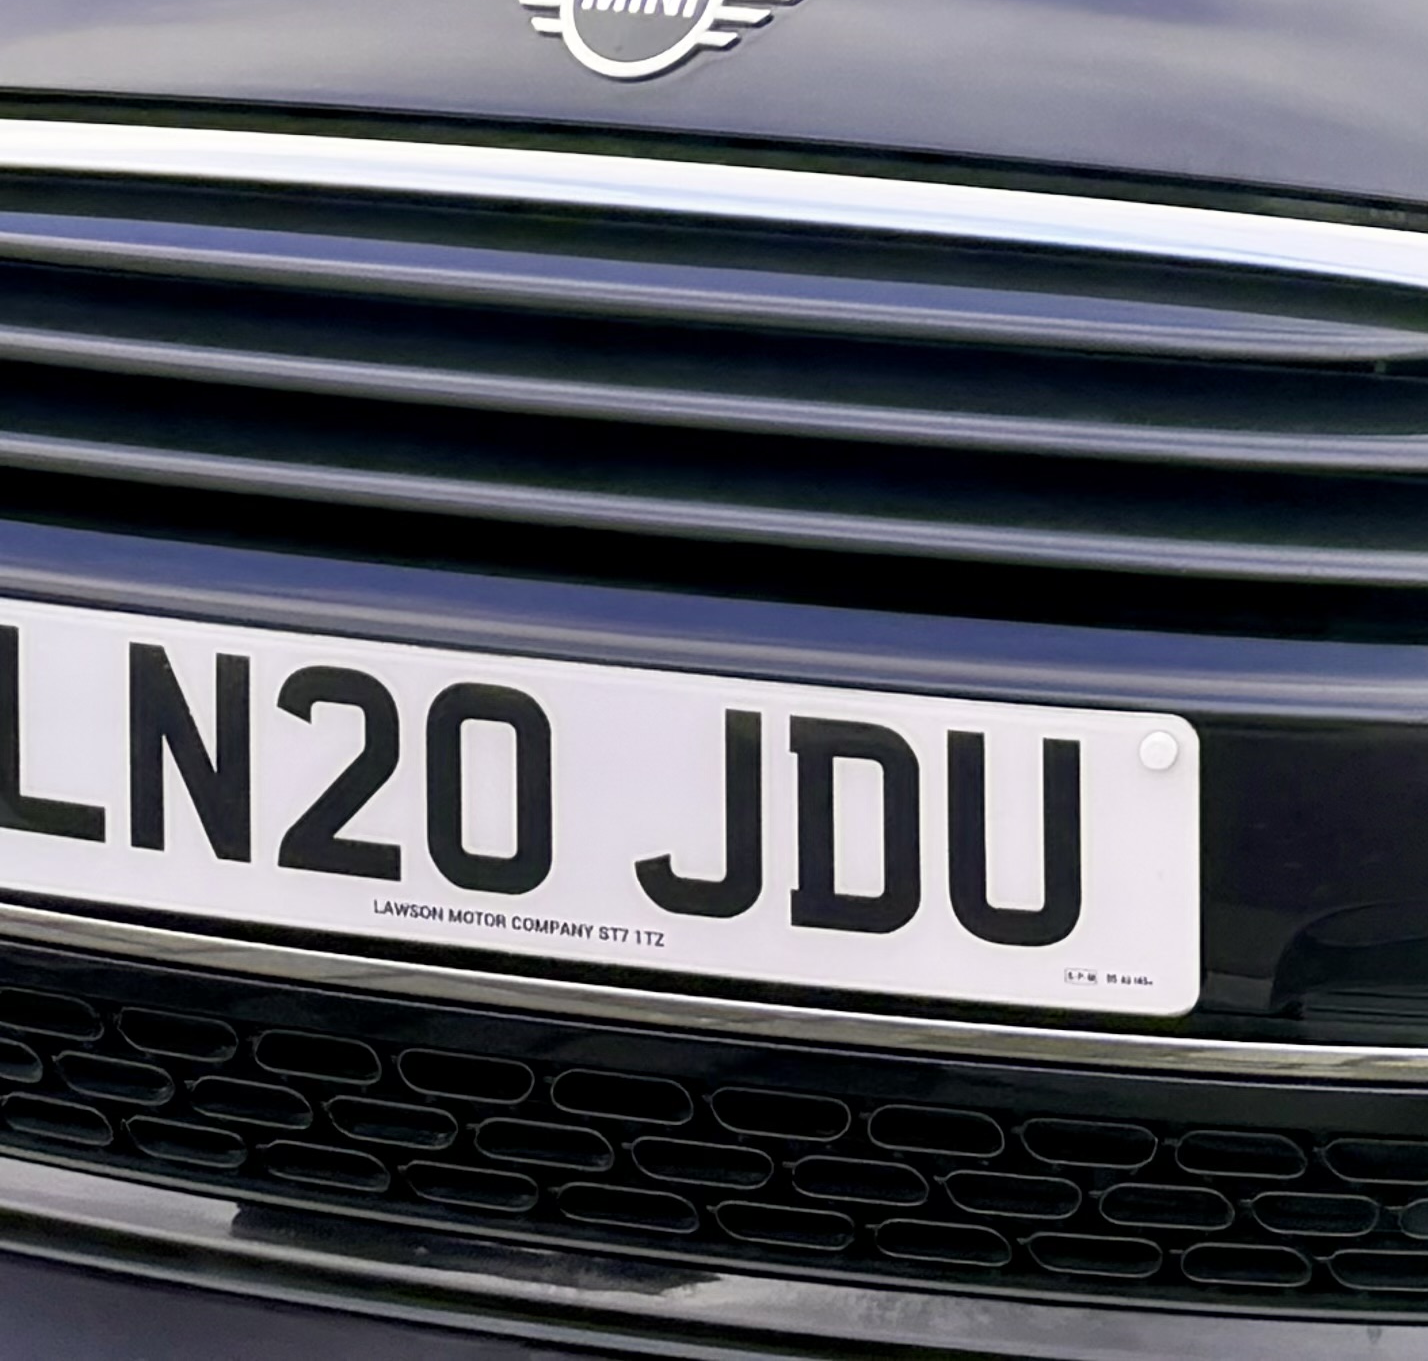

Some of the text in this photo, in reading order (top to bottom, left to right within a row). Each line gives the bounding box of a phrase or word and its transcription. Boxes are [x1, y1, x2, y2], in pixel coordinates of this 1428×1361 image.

[0, 625, 1082, 947] LN20 JDU
[374, 899, 665, 947] LAWSON MOTOR COMPANY ST7 1TZ
